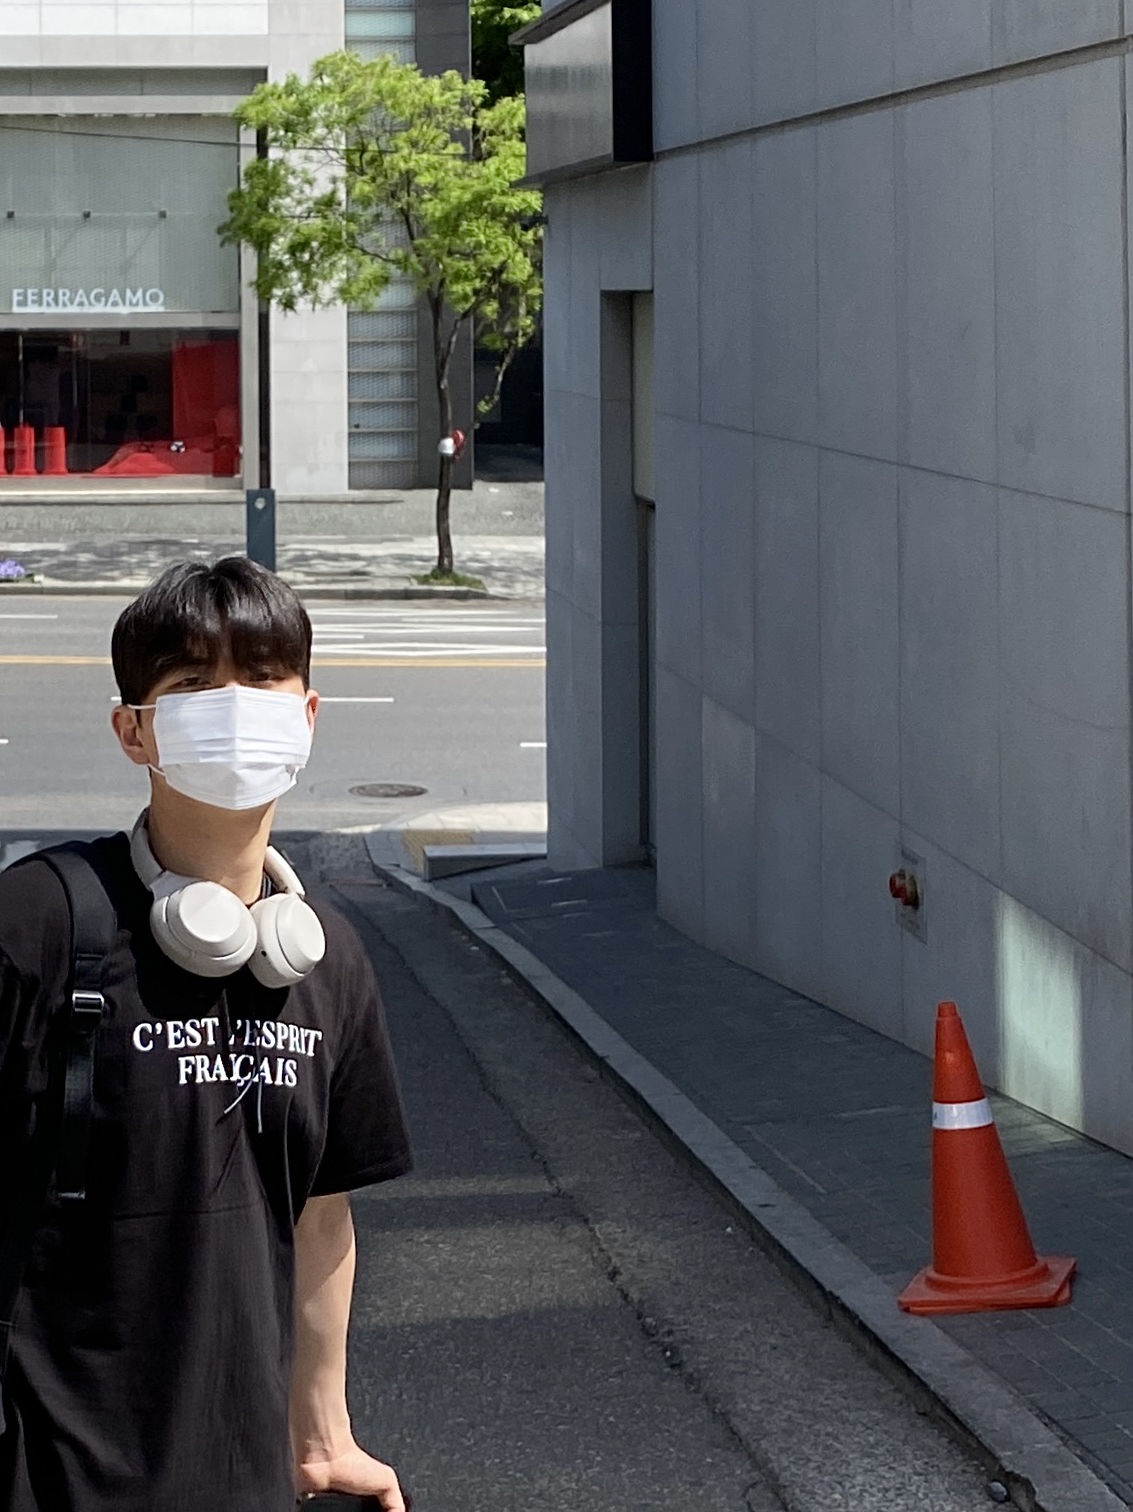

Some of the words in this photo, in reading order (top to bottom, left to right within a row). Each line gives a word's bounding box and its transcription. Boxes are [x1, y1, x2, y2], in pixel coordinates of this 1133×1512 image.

[11, 287, 165, 309] FERRAGAMO
[132, 1017, 219, 1051] C'EST
[228, 1018, 322, 1057] 'ESPRIT
